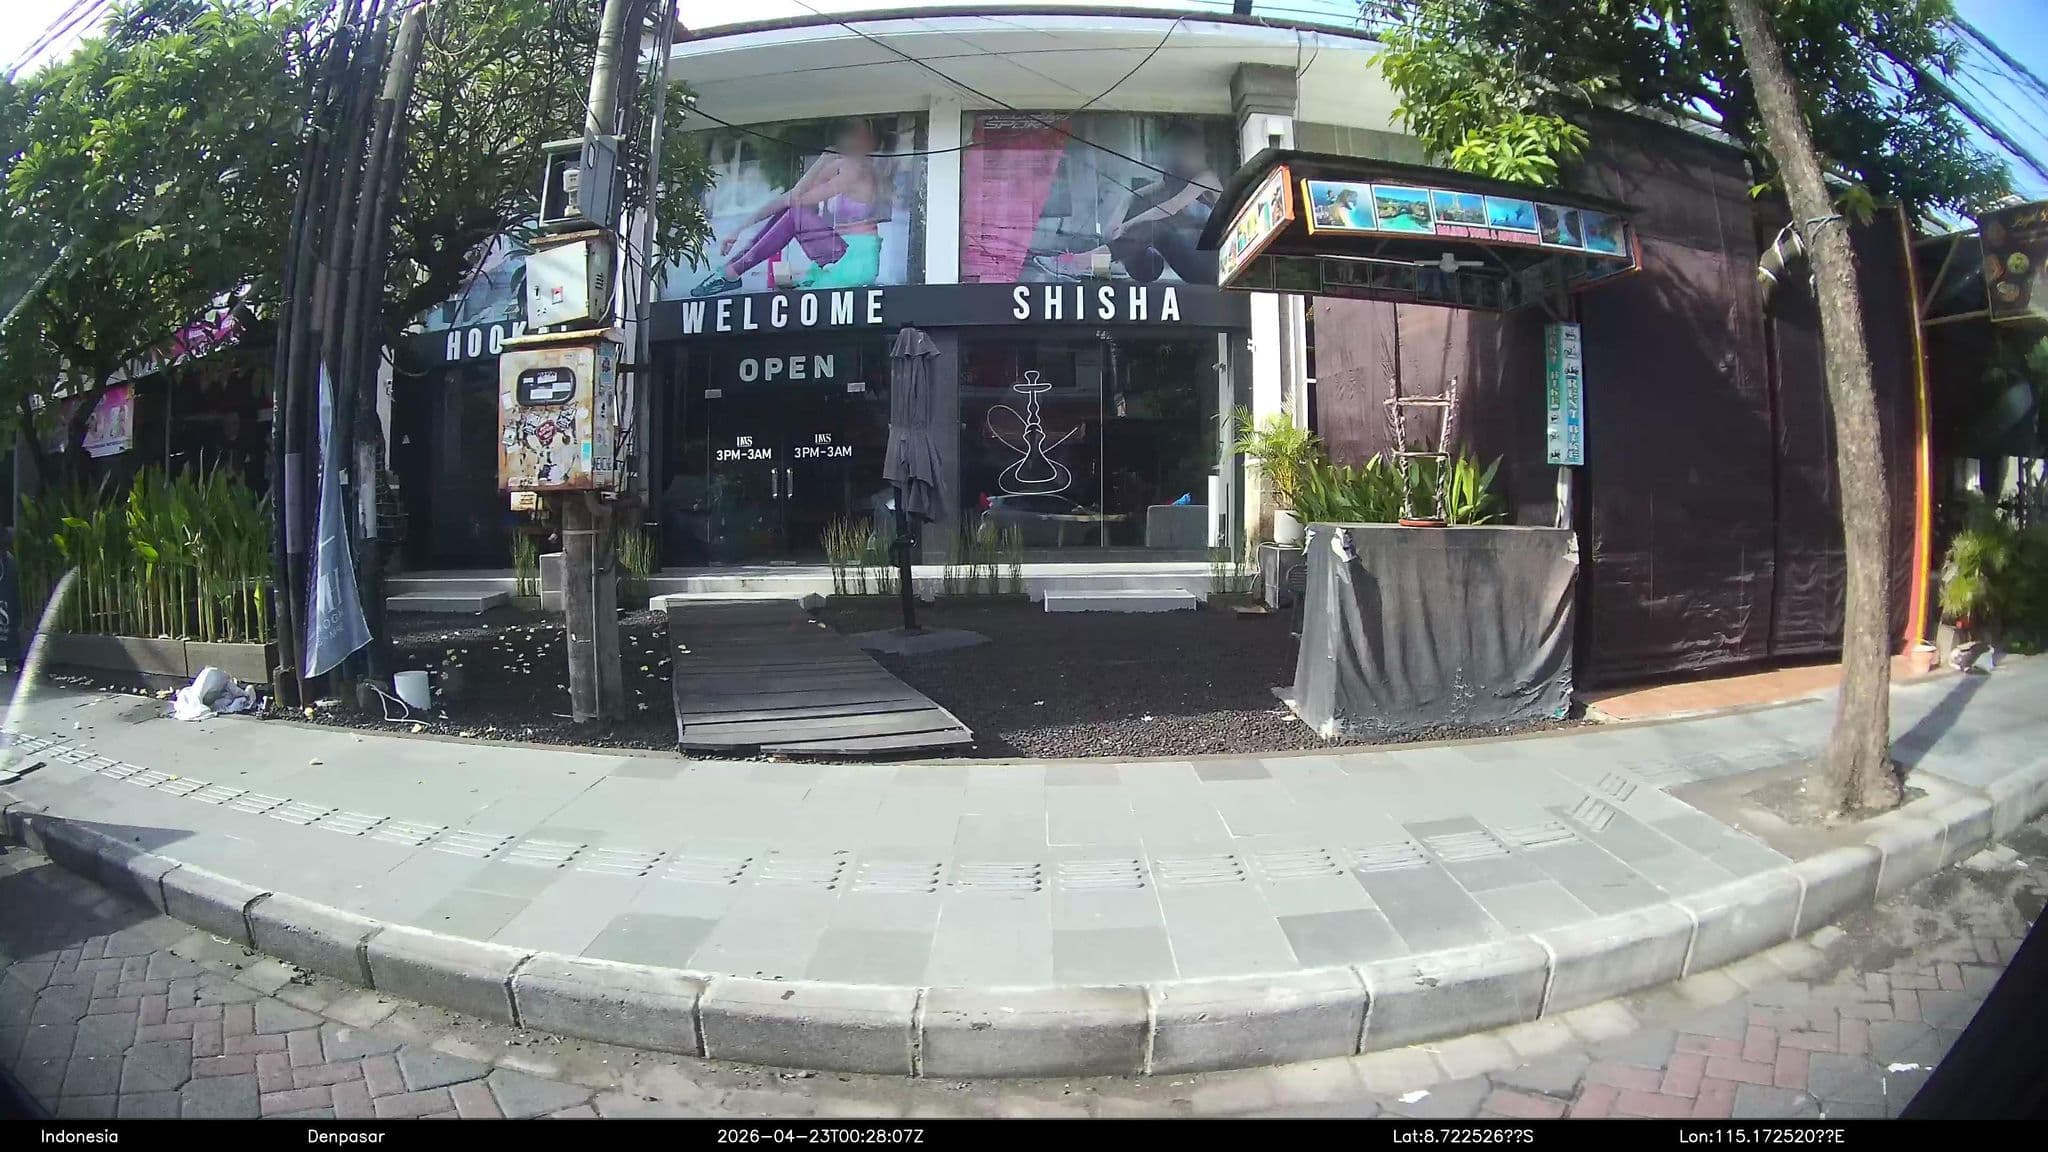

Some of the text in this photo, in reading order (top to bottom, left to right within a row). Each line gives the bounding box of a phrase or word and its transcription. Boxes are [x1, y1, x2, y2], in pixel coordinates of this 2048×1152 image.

[682, 290, 884, 334] WELCOME
[1013, 285, 1181, 321] SHISHA
[739, 354, 834, 382] OPEN
[716, 448, 772, 461] 3PM-3AM
[794, 445, 852, 458] 3PM-3AM
